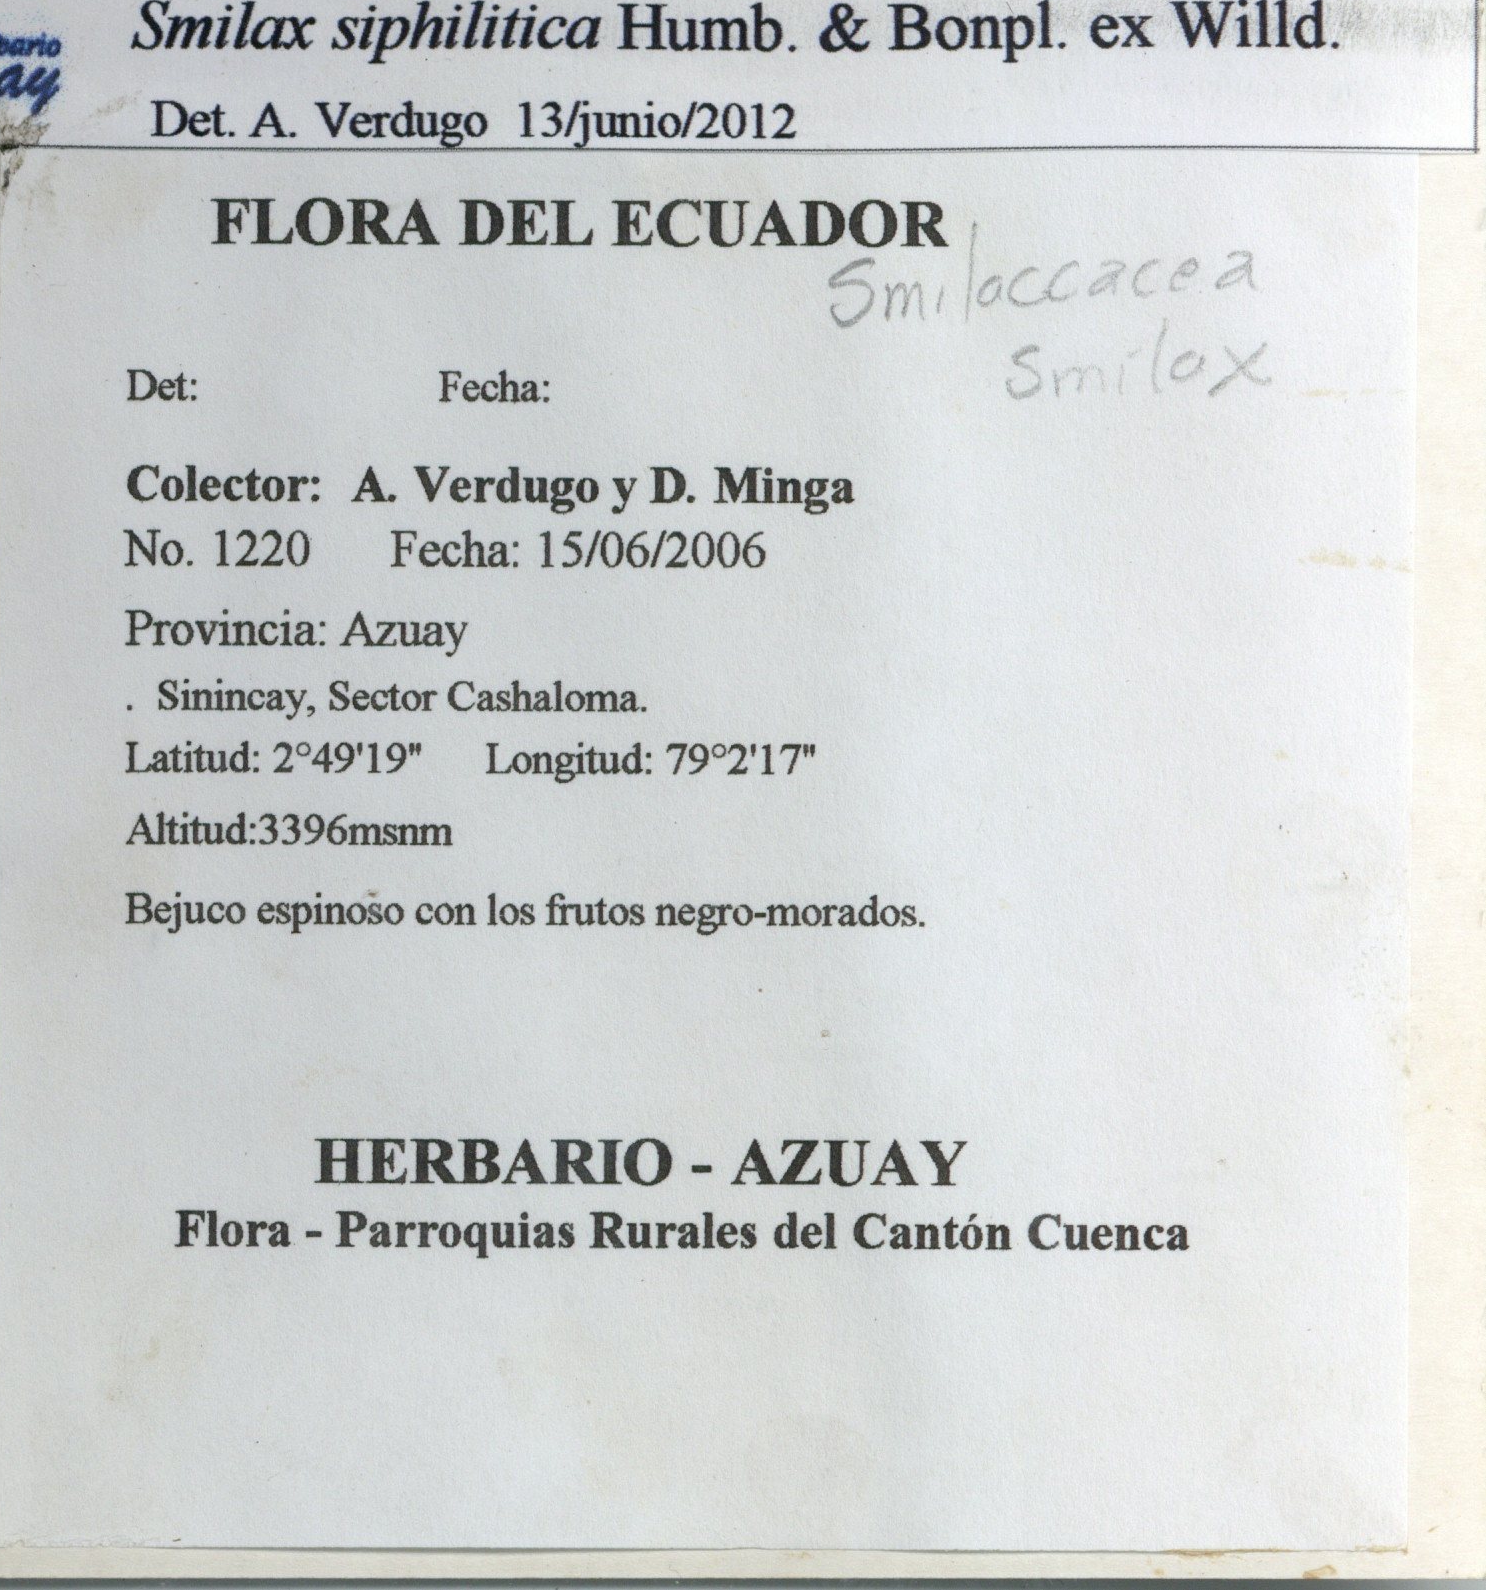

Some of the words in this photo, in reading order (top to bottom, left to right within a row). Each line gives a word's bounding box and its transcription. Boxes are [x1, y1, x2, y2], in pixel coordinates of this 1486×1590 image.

[330, 0, 603, 65] siphilitica
[616, 1, 798, 53] Humb.
[818, 2, 871, 54] &
[1089, 13, 1155, 50] ex
[150, 99, 236, 138] Det.
[247, 101, 298, 139] A.
[313, 99, 489, 148] Verdugo
[518, 99, 798, 148] 13/junio/2012
[210, 197, 440, 246] FLORA
[458, 199, 594, 246] DEL
[611, 198, 949, 248] ECUADOR
[126, 368, 198, 402] Det:
[438, 368, 550, 405] Fecha:
[126, 464, 321, 504] Colector:
[350, 465, 397, 503] A.
[412, 465, 600, 516] Verdugo
[611, 477, 638, 515] y
[649, 466, 696, 505] D.
[713, 466, 856, 516] Minga
[122, 528, 194, 568] No.
[214, 528, 311, 568] 1220
[390, 528, 520, 568] Fecha:
[539, 529, 767, 569] 15/06/2006
[124, 608, 326, 647] Provincia:
[338, 610, 469, 658] Azuay
[157, 677, 316, 721] Sinincay,
[328, 679, 439, 712] Sector
[447, 679, 647, 713] Cashaloma.
[124, 739, 260, 774] Latitud:
[485, 741, 652, 785] Longitud:
[125, 810, 454, 847] Altitud:3396msnm
[124, 890, 247, 935] Bejuco
[256, 891, 405, 935] espinoso
[414, 901, 478, 926] con
[486, 892, 536, 927] los
[545, 892, 646, 927] frutos
[655, 894, 926, 937] negro-morados.
[313, 1137, 674, 1188] HERBARIO
[730, 1138, 968, 1188] AZUAY
[173, 1209, 292, 1248] Flora
[334, 1210, 576, 1260] Parroquias
[588, 1210, 758, 1250] Rurales
[773, 1211, 838, 1250] del
[852, 1212, 1013, 1251] Cantón
[1027, 1213, 1190, 1252] Cuenca
